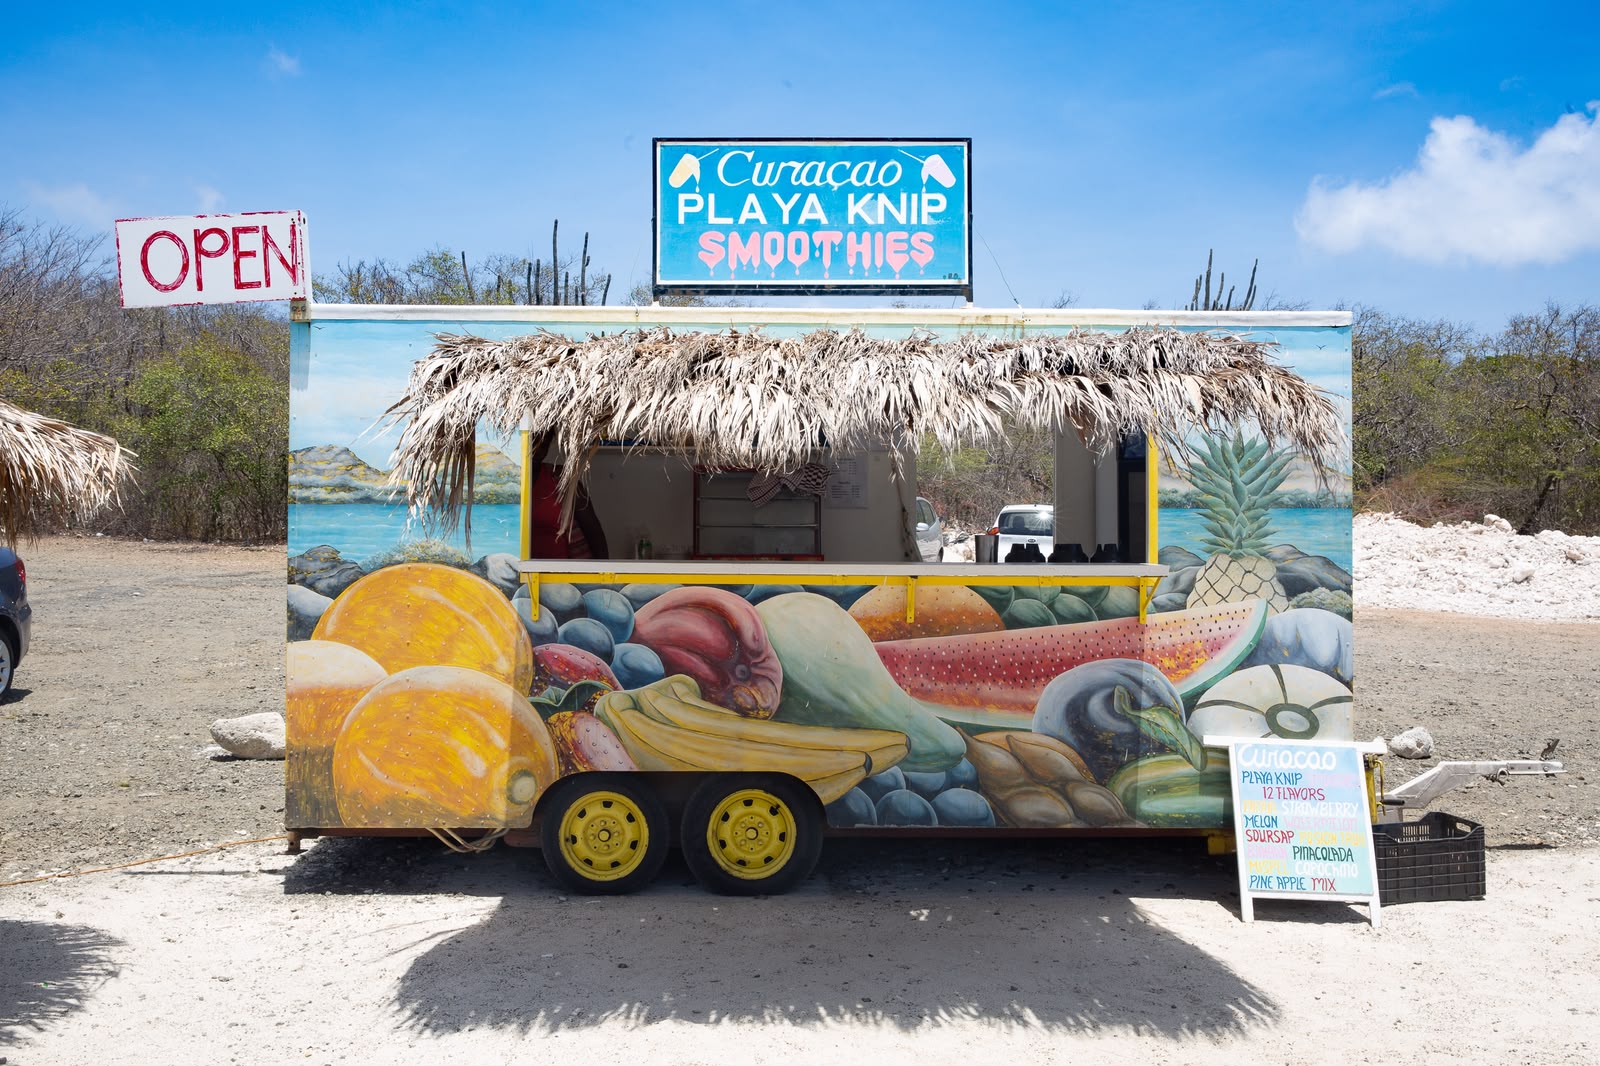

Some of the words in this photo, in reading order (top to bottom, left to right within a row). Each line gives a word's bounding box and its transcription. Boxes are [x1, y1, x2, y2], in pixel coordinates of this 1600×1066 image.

[717, 150, 903, 191] Curaçao
[677, 193, 829, 225] PLAYA
[847, 193, 948, 225] KNIP
[139, 224, 299, 293] OPEN
[698, 231, 935, 277] SMOOTHIES
[1242, 771, 1273, 785] PLAYA
[1276, 772, 1303, 786] KNIP
[1262, 786, 1274, 800] 12
[1243, 814, 1278, 828] MELON
[1245, 829, 1294, 844] SOURSAP
[1293, 845, 1354, 862] PINACOLADA
[1249, 875, 1274, 890] PINE
[1276, 876, 1306, 891] APPLE
[1311, 877, 1337, 892] MIX
